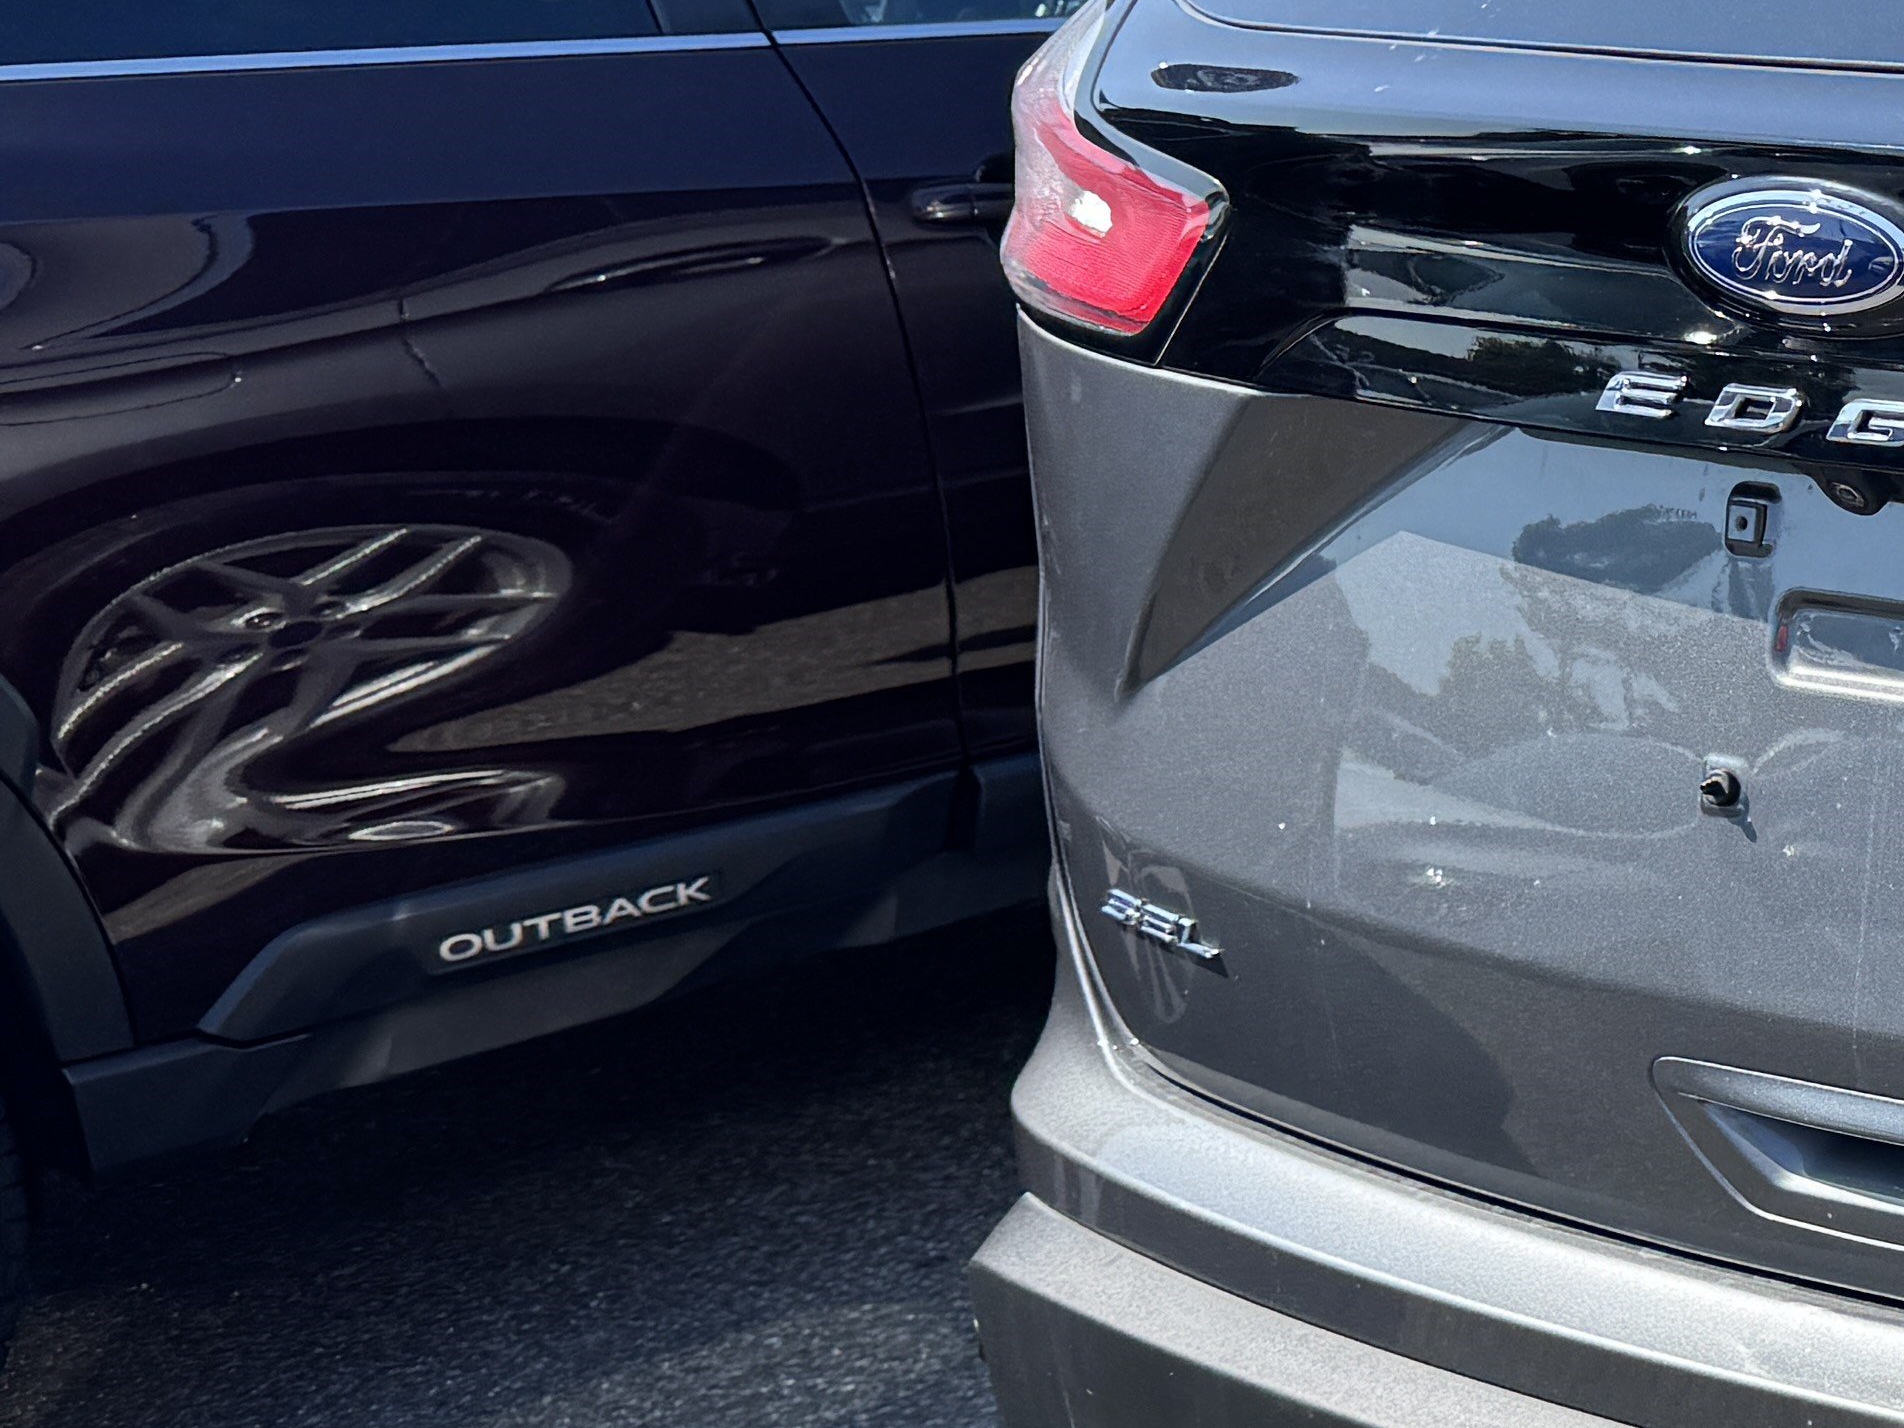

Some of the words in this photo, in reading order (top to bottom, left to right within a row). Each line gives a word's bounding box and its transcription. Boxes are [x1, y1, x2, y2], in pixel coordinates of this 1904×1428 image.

[1731, 215, 1854, 288] Ford
[438, 875, 712, 963] OUTBACK
[1101, 887, 1224, 960] SEL
